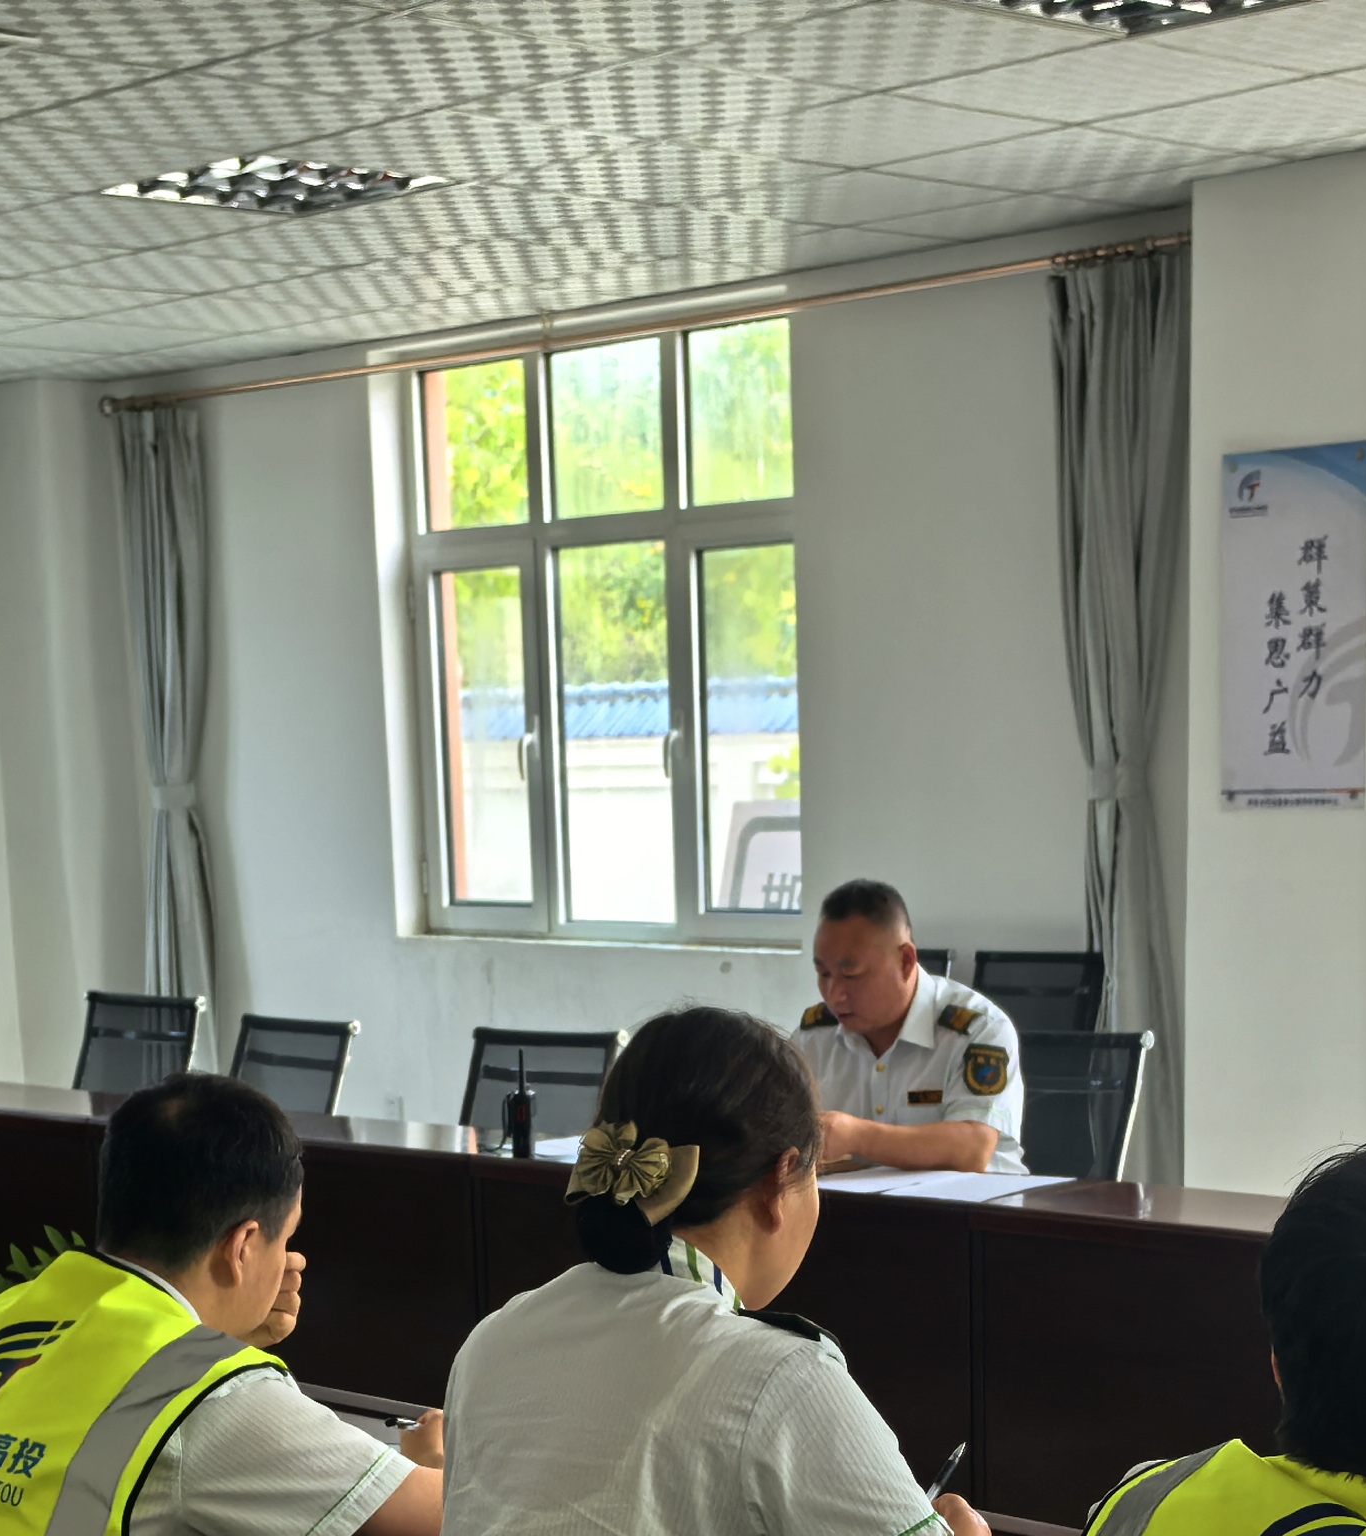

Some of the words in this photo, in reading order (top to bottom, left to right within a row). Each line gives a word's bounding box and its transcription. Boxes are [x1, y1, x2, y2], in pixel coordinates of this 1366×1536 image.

[1263, 590, 1292, 756] 集思广益
[1296, 535, 1329, 699] 群策群力
